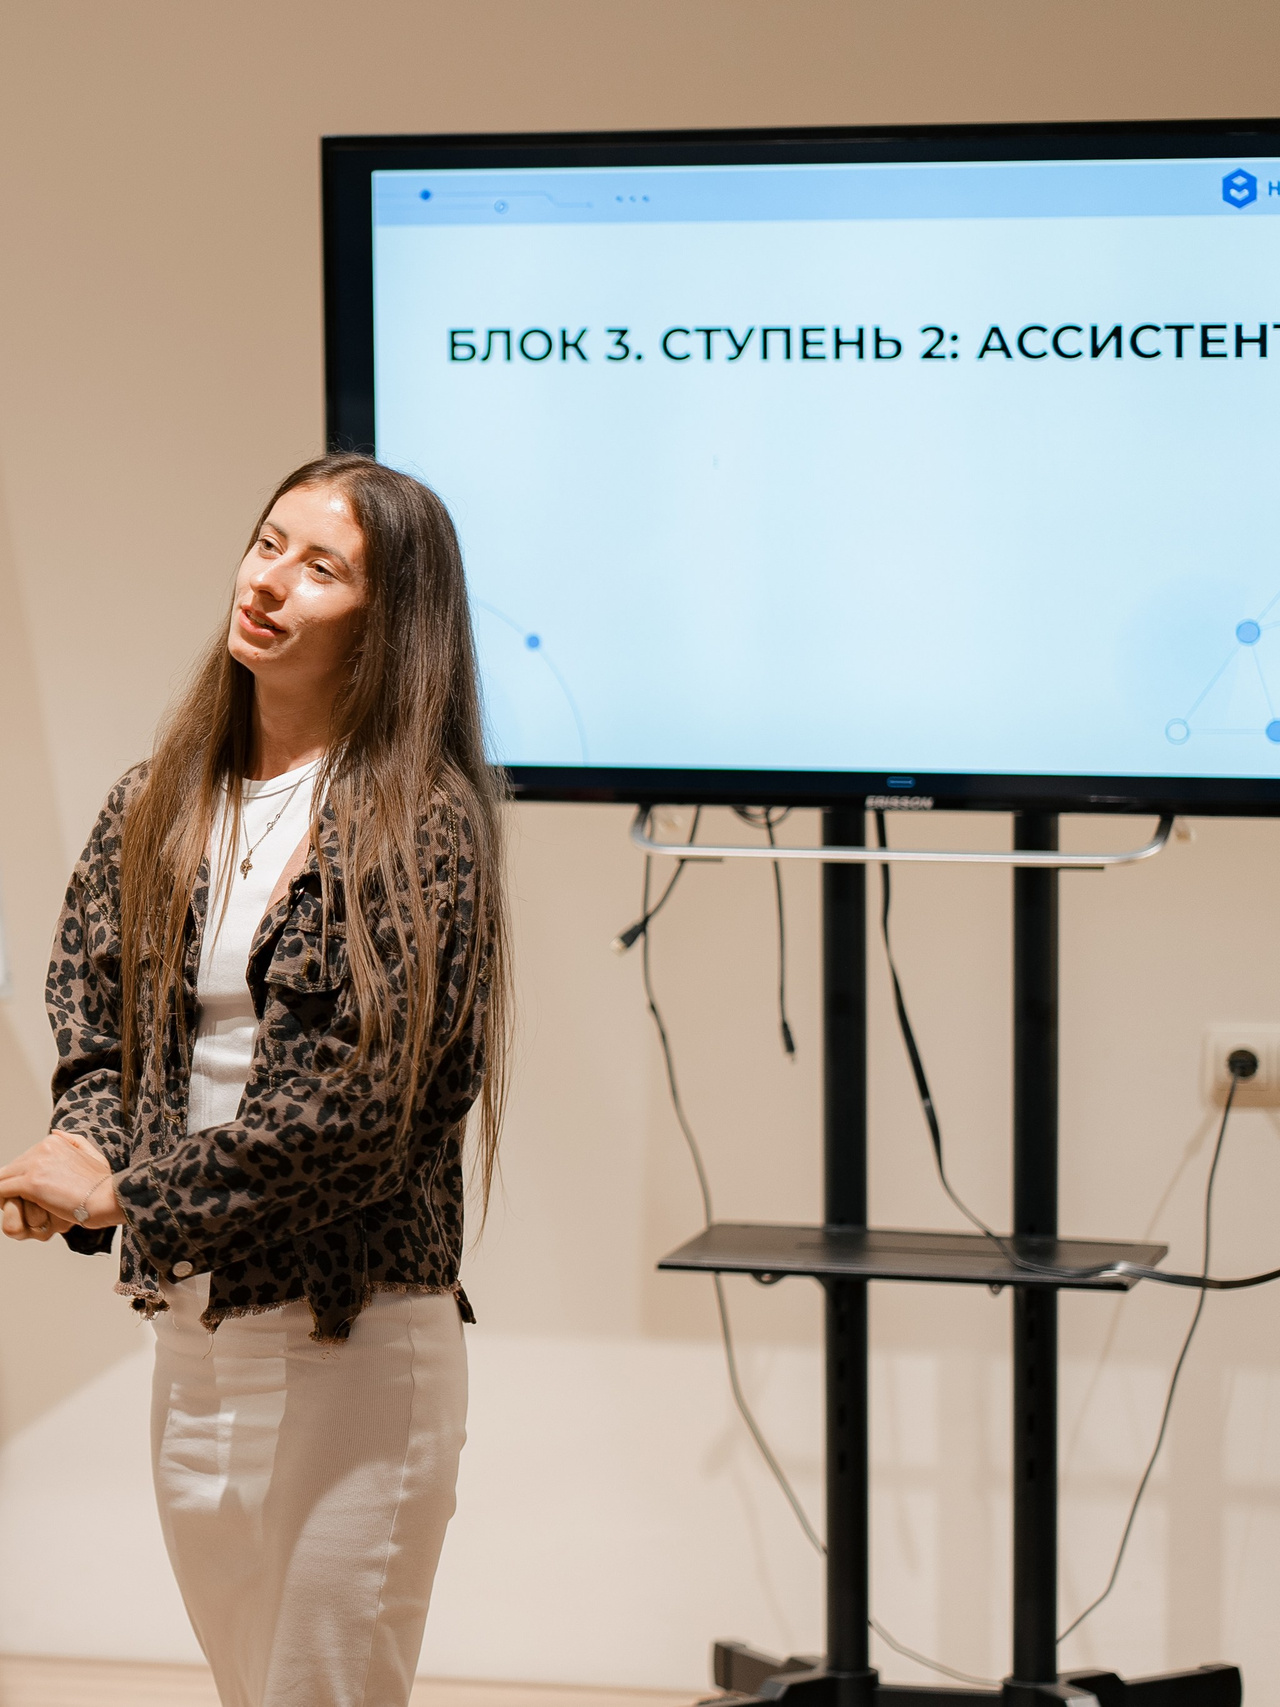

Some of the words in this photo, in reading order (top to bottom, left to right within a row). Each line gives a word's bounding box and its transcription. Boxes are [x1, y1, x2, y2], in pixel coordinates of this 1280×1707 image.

[448, 327, 589, 362] БЛОК
[605, 327, 643, 362] 3.
[661, 325, 902, 361] СТУПЕНЬ
[919, 325, 960, 360] 2:
[976, 323, 1280, 360] АССИСТЕН
